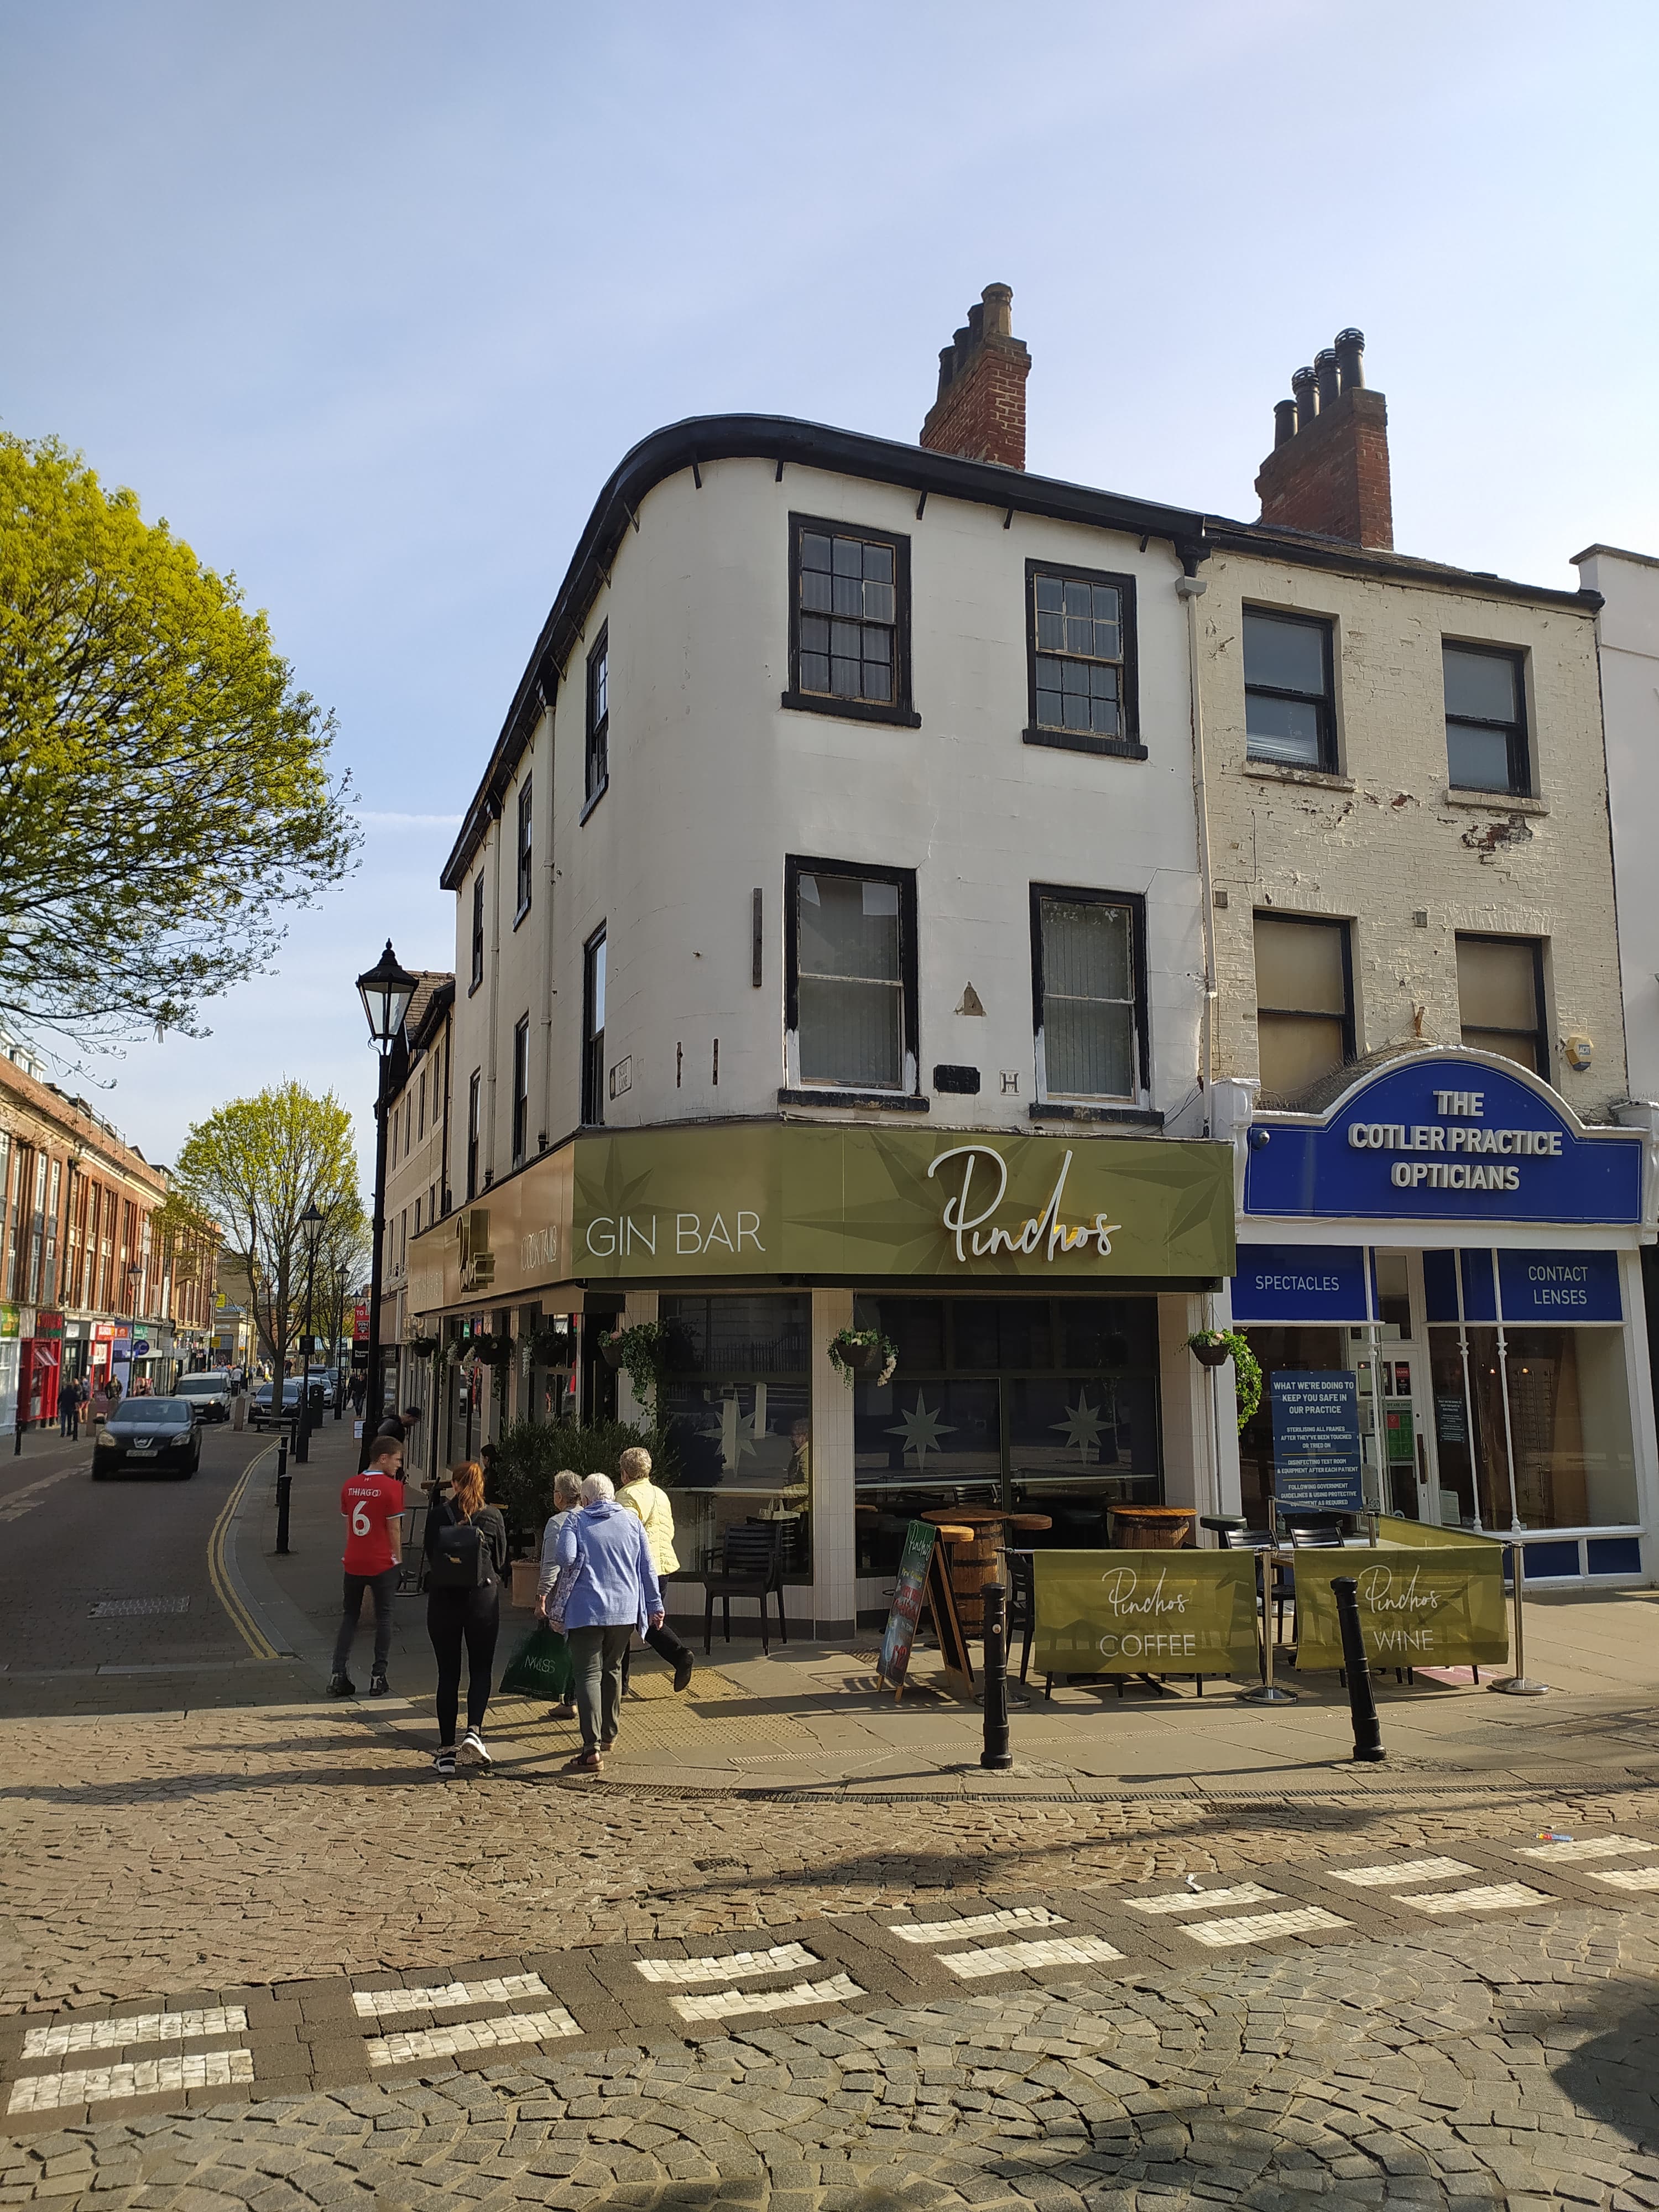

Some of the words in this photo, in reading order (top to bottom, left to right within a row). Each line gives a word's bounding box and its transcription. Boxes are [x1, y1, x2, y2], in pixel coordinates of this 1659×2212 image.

[1433, 1090, 1485, 1117] THE
[1348, 1123, 1445, 1151] COTLER
[1446, 1127, 1563, 1156] PRACTICE
[1391, 1162, 1520, 1190] OPTICIANS
[927, 1144, 1121, 1262] Pinchos
[586, 1215, 656, 1257] GIN
[676, 1211, 766, 1254] BAR
[1255, 1275, 1340, 1291] SPECTACLES
[1528, 1266, 1588, 1282] CONTACT
[1533, 1288, 1588, 1305] LENSES
[1274, 1381, 1296, 1390] WHAT
[1297, 1381, 1321, 1390] WE'RE
[1322, 1381, 1343, 1390] DOING
[1289, 1406, 1304, 1414] OUR
[1305, 1406, 1342, 1414] PRACTICE
[348, 1488, 382, 1498] THIAGO
[352, 1500, 371, 1536] 6
[1102, 1567, 1190, 1618] Pinchos
[1358, 1564, 1442, 1614] Pinchos
[1099, 1634, 1196, 1657] COFFEE
[1373, 1630, 1434, 1652] WINE
